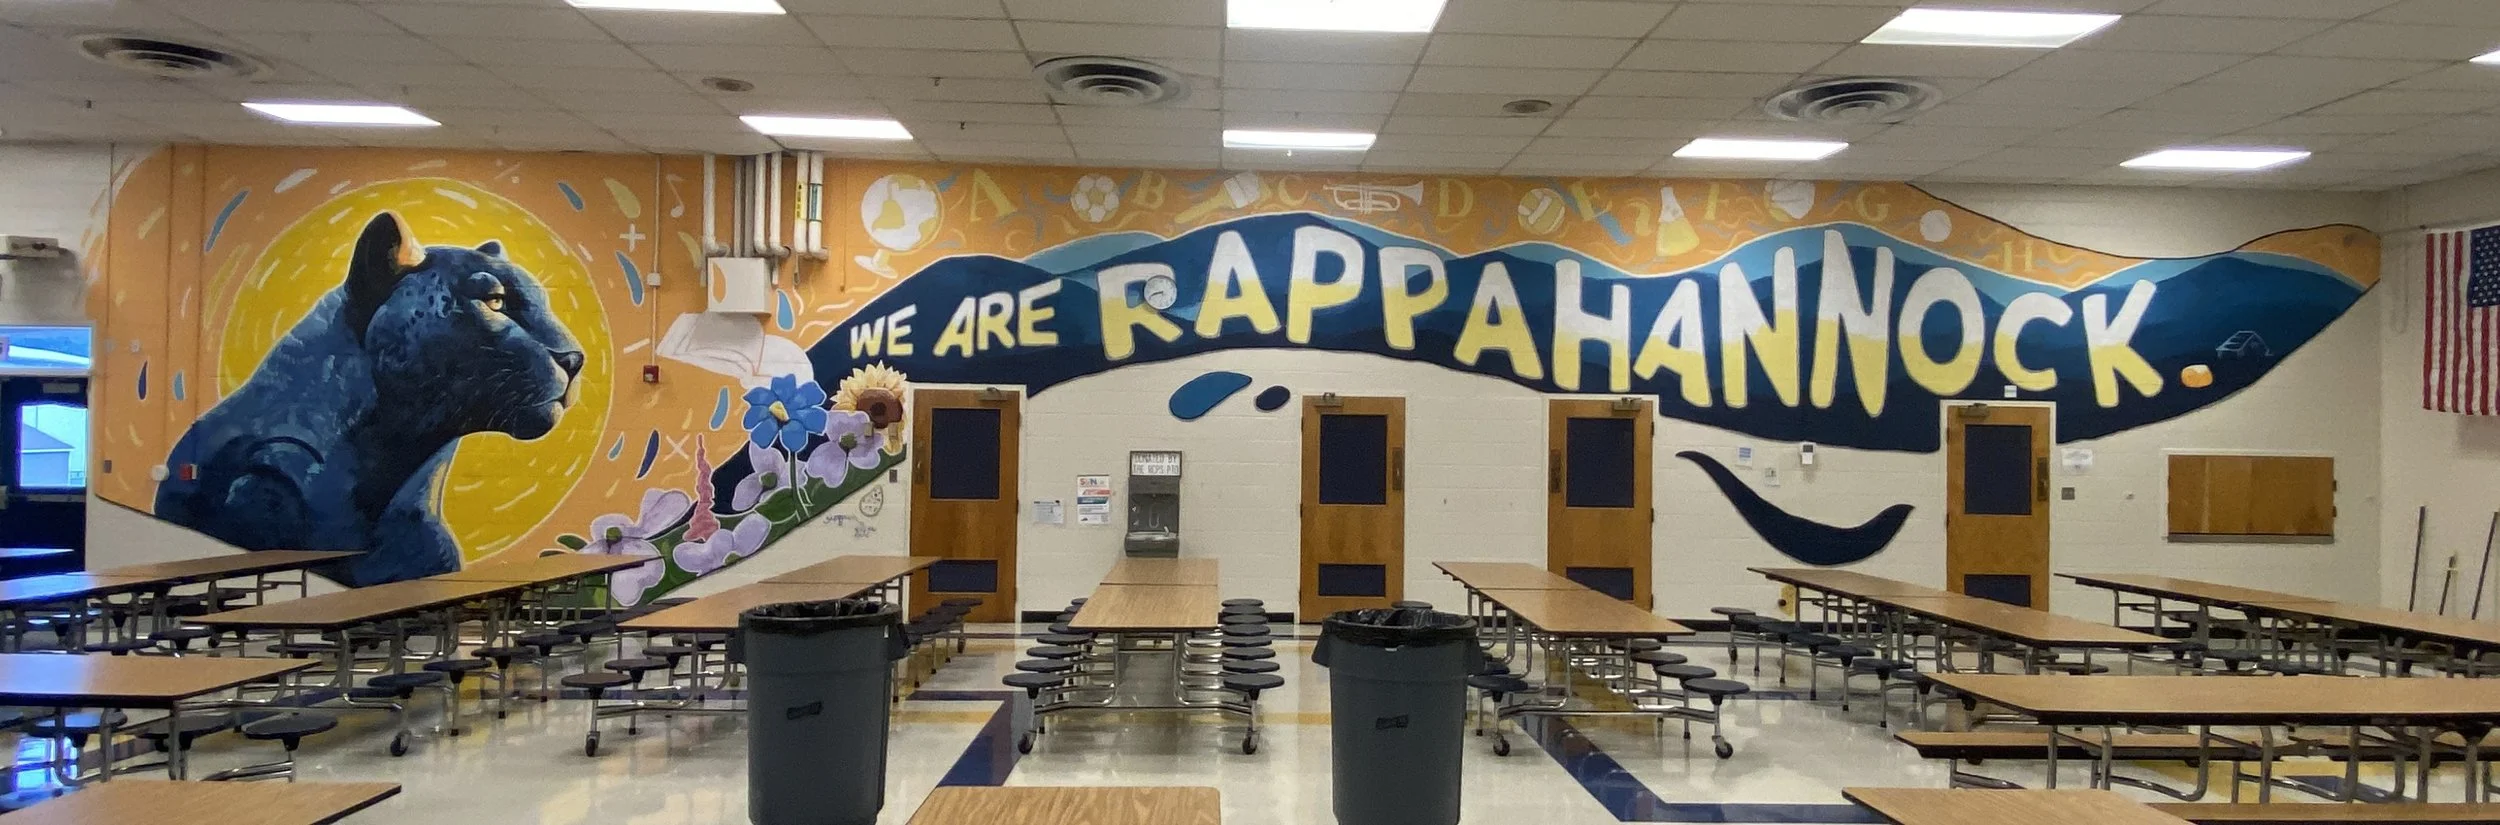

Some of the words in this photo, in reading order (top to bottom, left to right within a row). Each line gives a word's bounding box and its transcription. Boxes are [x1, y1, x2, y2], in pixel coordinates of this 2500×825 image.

[970, 168, 1017, 222] A
[1131, 170, 1168, 210] B
[1438, 178, 1474, 217] D
[1856, 187, 1891, 222] G
[850, 303, 918, 360] WE
[932, 278, 1063, 358] ARE
